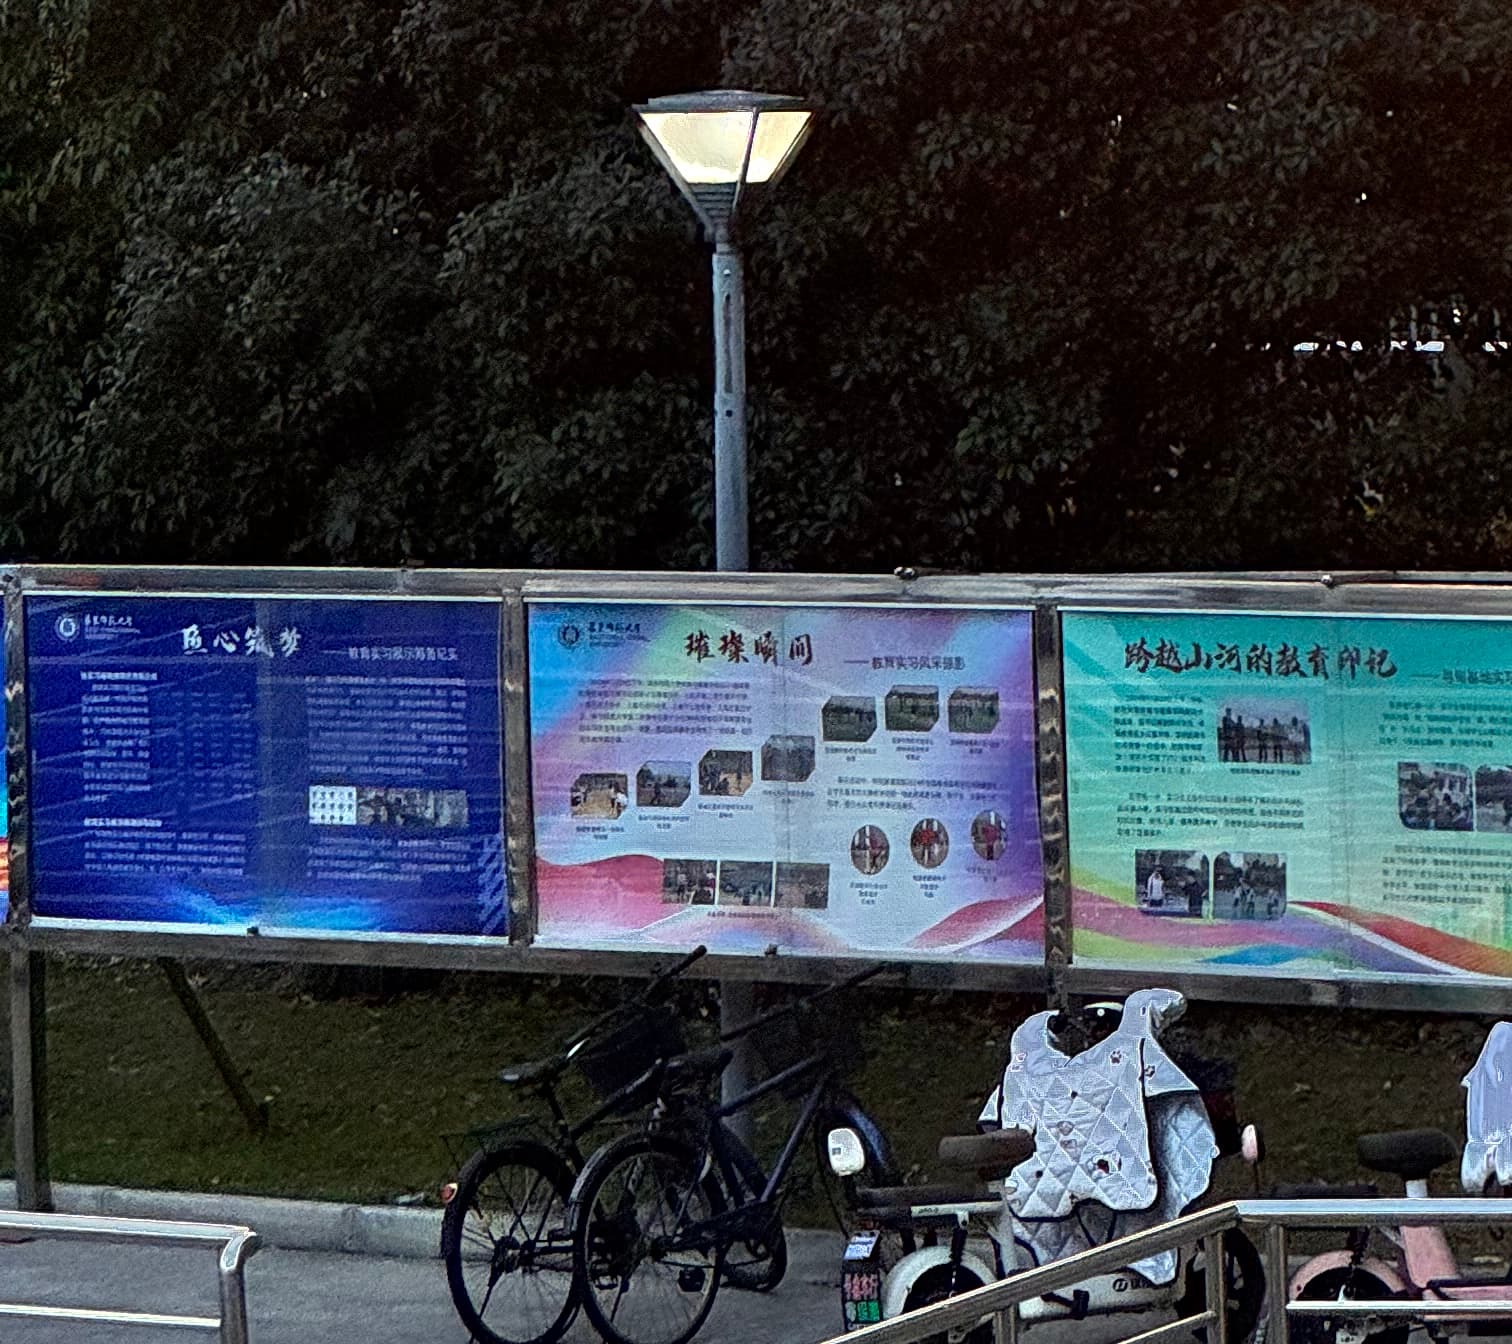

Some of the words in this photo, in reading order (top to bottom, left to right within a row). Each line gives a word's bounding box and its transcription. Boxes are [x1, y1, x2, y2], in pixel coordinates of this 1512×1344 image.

[684, 629, 813, 666] 璀璨瞬间
[1124, 637, 1398, 680] 跨越山河的教育印记
